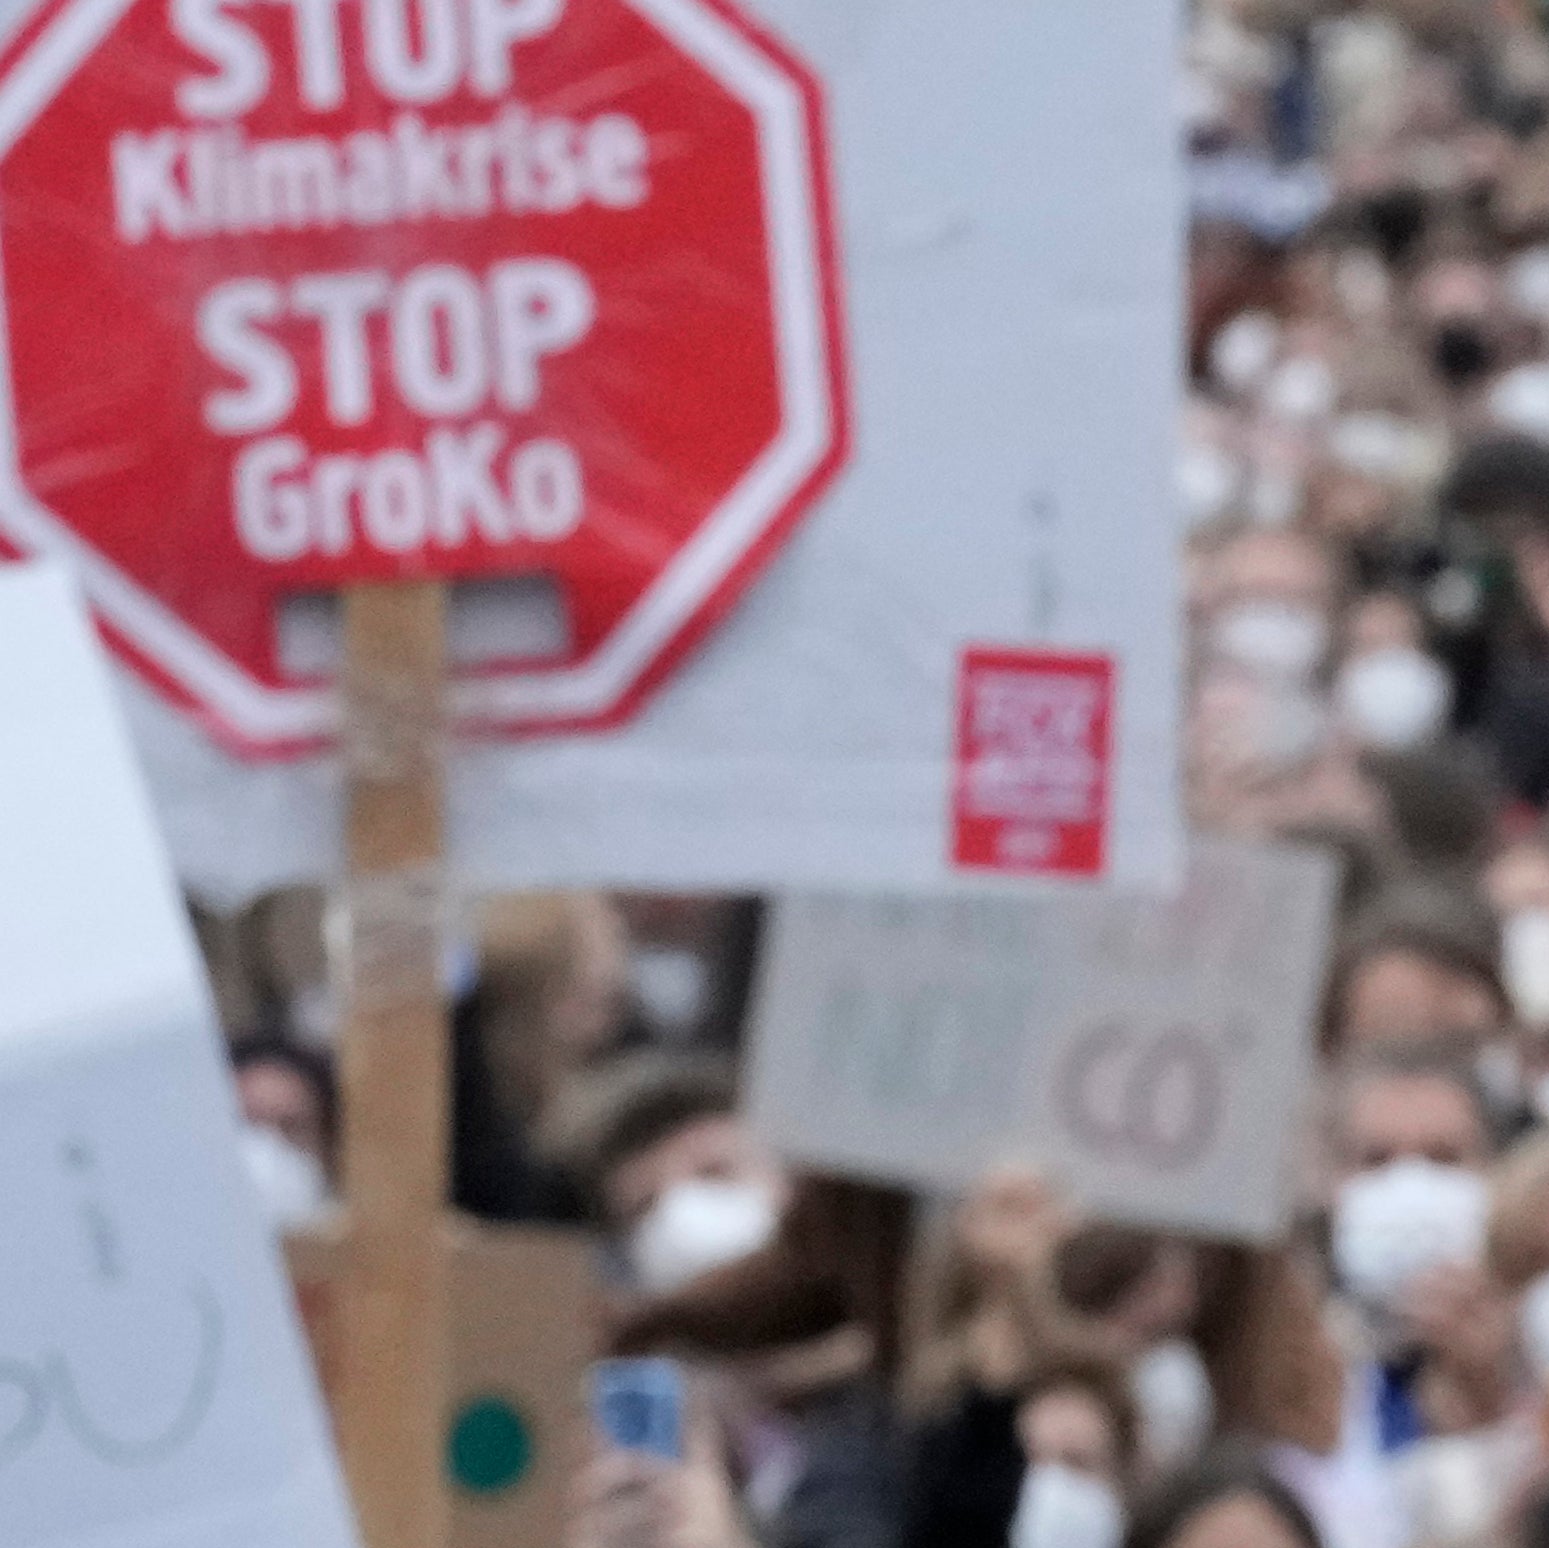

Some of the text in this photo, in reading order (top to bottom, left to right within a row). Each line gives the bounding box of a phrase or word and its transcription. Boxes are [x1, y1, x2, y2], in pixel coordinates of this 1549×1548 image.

[170, 0, 566, 117] STOP
[110, 102, 652, 244] Klimakrise
[196, 254, 596, 436] STOP
[230, 420, 586, 562] GroKo
